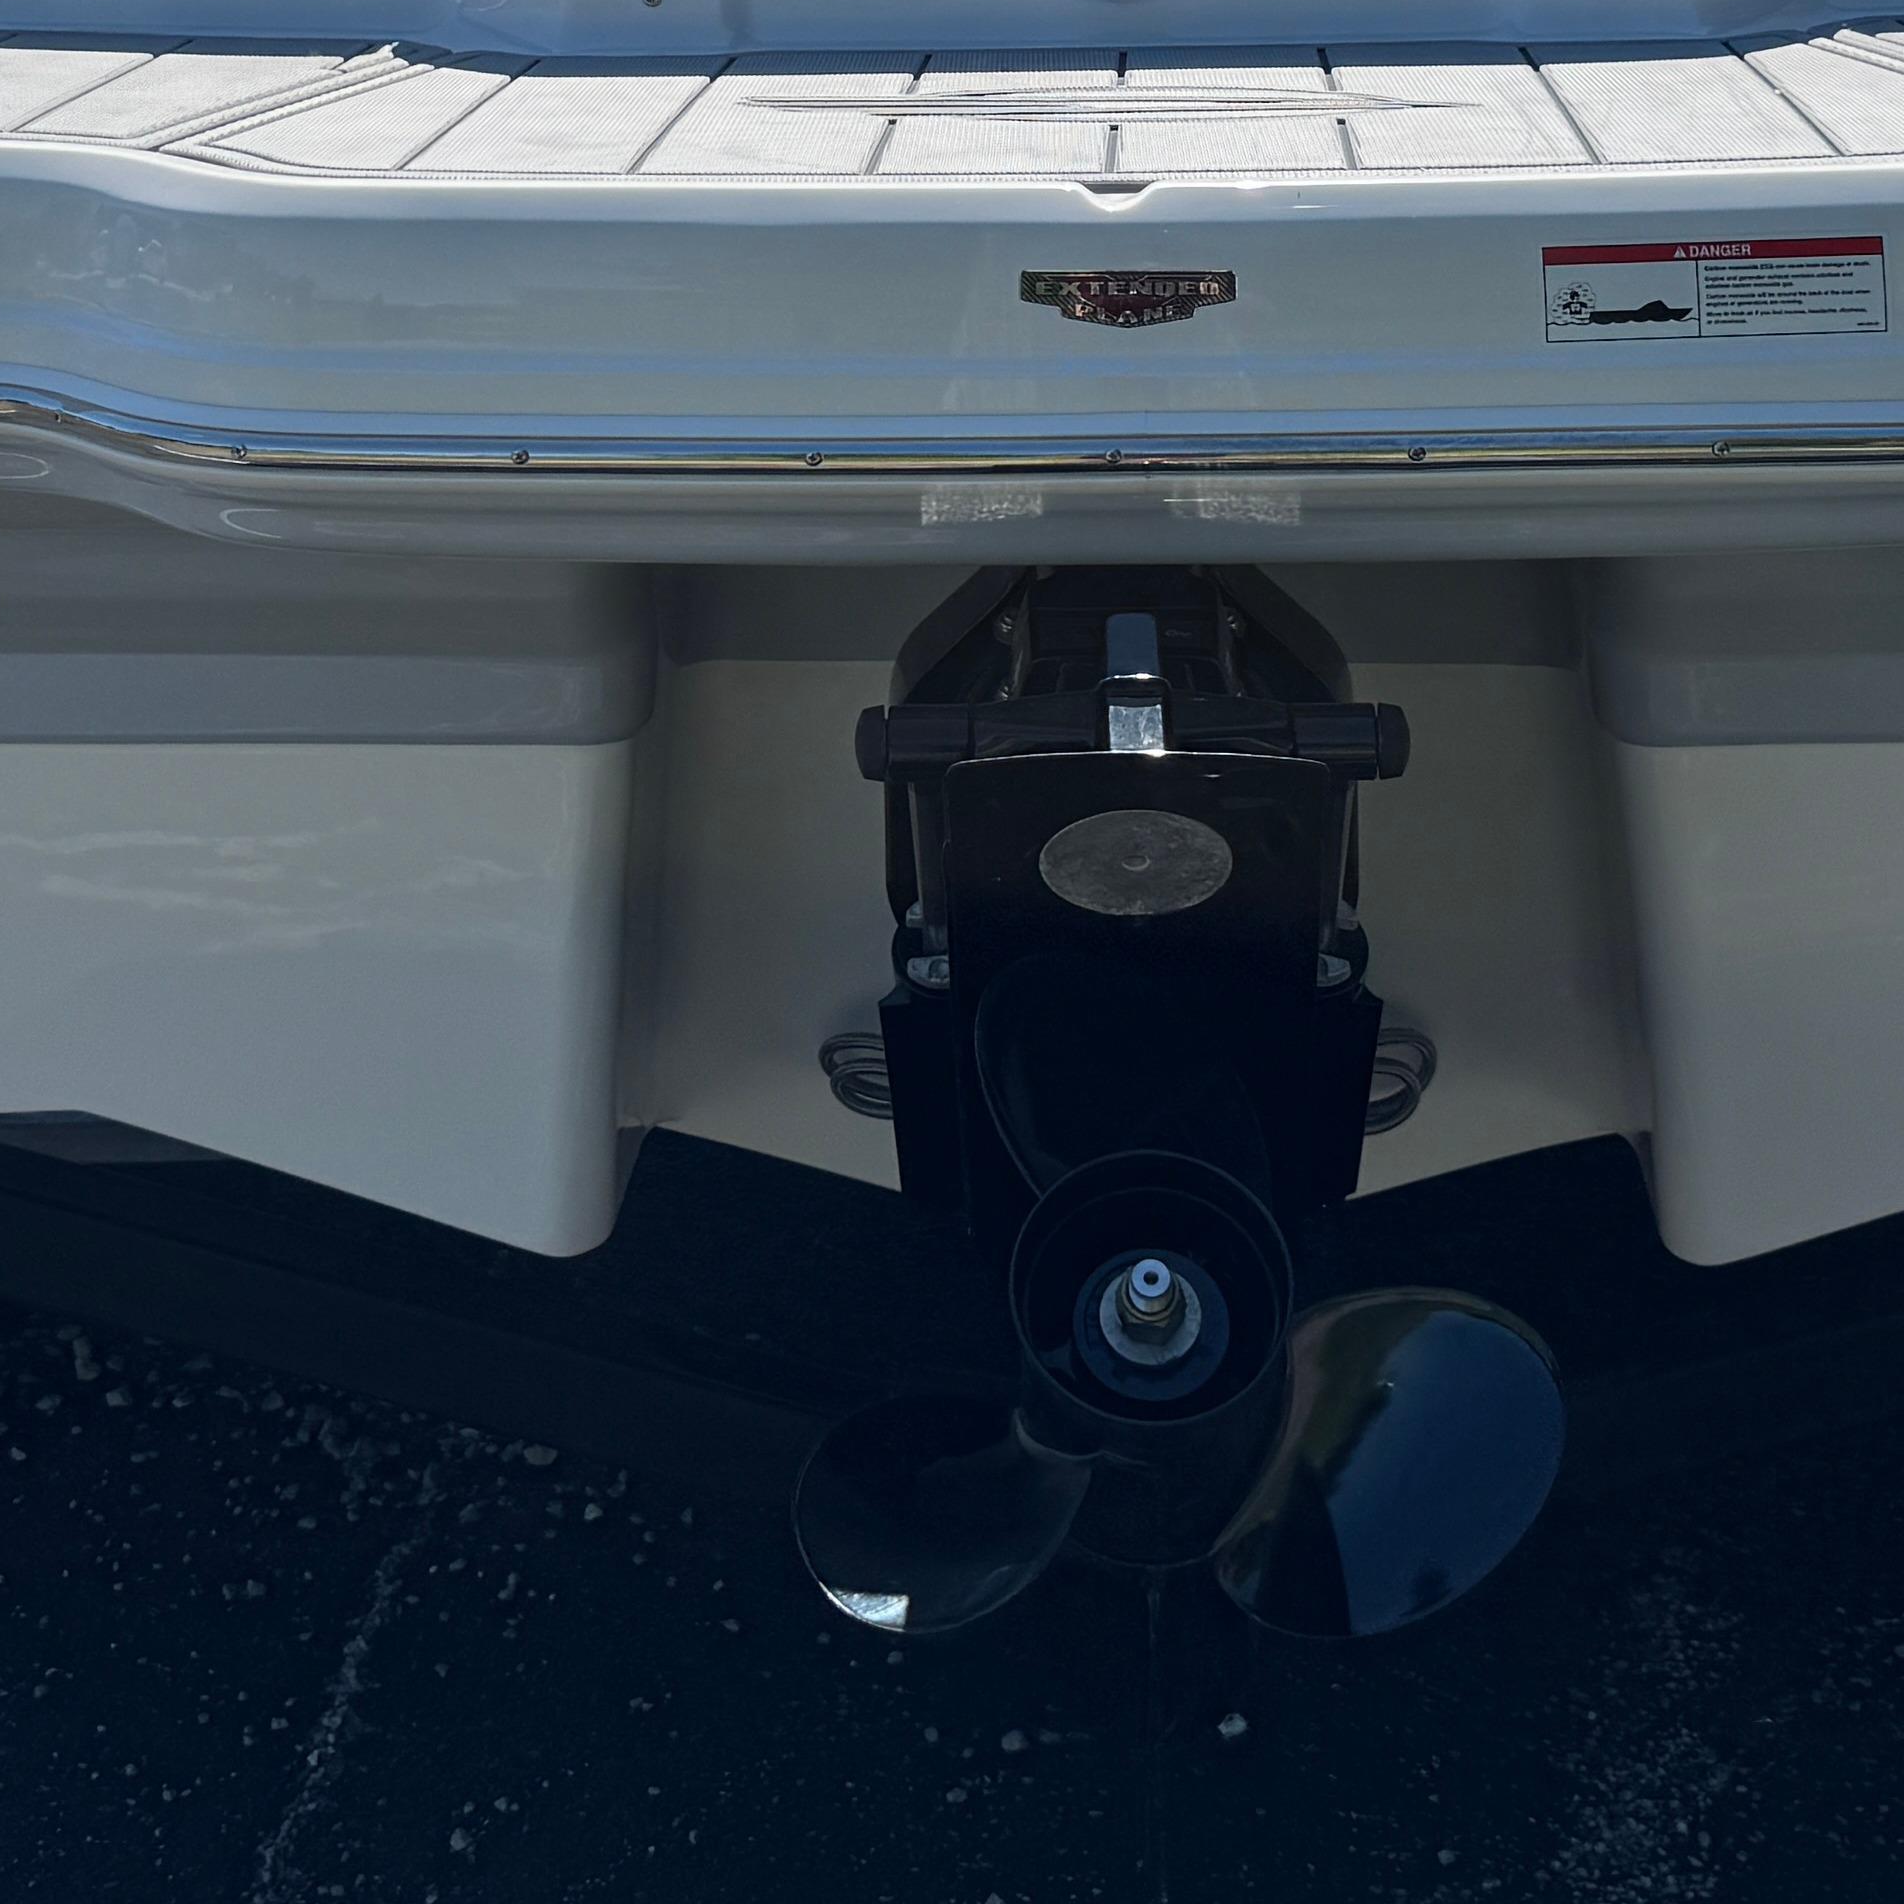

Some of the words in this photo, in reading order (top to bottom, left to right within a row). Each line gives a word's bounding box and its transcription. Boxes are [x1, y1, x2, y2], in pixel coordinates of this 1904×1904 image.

[1689, 244, 1752, 258] DANGER
[1035, 281, 1220, 296] EXTENDED
[1075, 303, 1183, 324] PLANE
